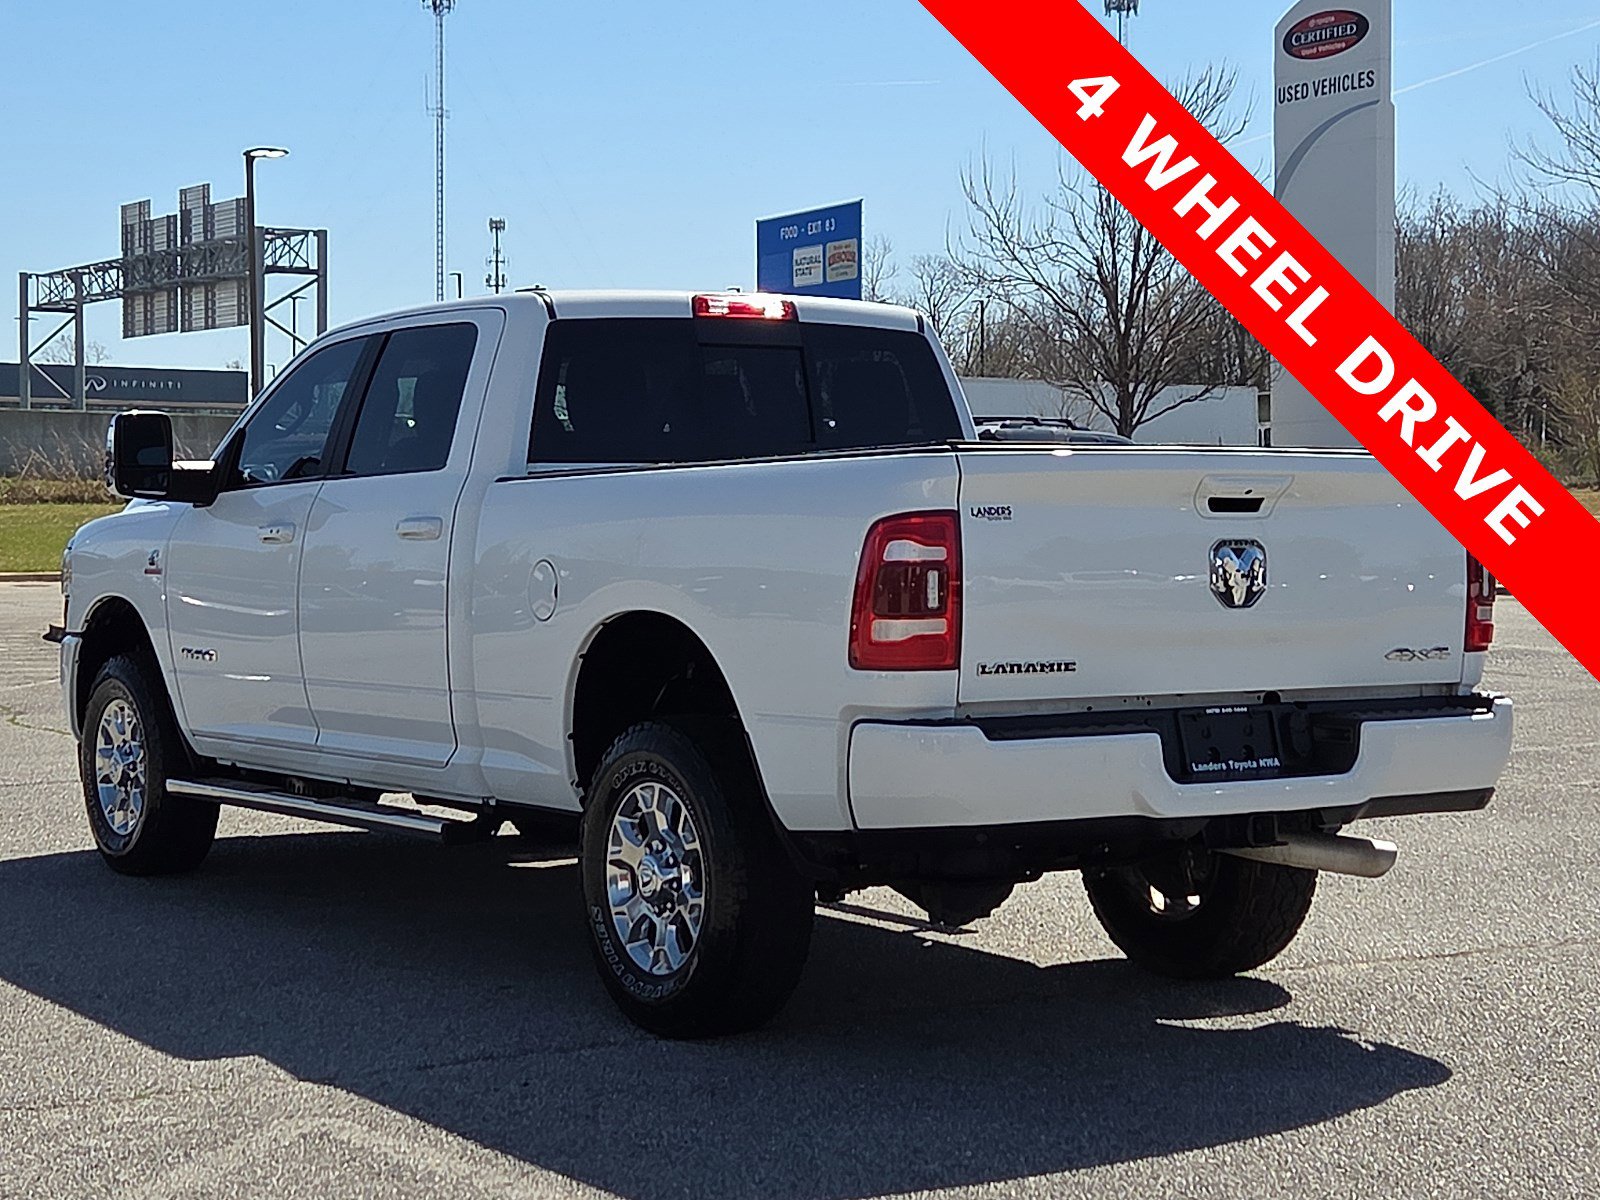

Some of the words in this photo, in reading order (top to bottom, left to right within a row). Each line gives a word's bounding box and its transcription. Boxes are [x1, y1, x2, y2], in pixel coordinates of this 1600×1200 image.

[1291, 23, 1357, 46] CERTIFIED
[1278, 82, 1309, 104] USED
[1312, 70, 1375, 98] VEHICLES
[780, 225, 798, 241] FOOD
[808, 220, 822, 235] EXIT
[113, 379, 182, 390] INFINITI
[970, 506, 1012, 518] LANDERS
[977, 661, 1077, 676] LARAMIE
[1192, 761, 1227, 772] Landers
[1228, 759, 1258, 772] Toyota
